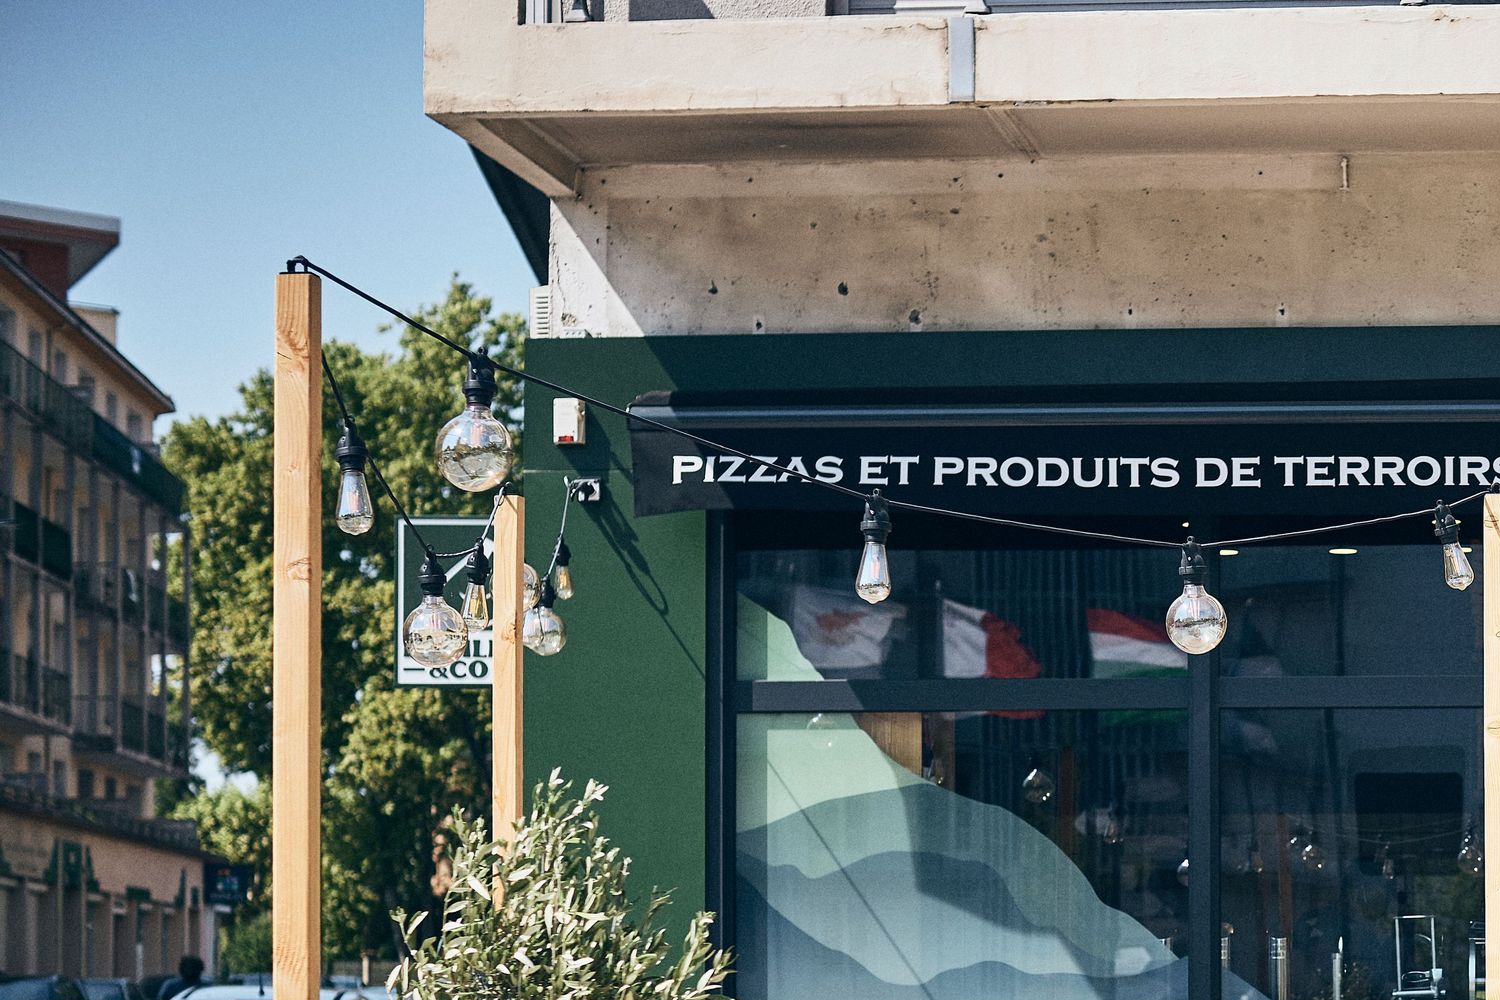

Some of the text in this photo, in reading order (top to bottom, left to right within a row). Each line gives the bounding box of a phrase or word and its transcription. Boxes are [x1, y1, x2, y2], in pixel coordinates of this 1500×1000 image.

[672, 455, 844, 485] PIZZAS
[859, 455, 920, 486] ET
[933, 456, 1180, 488] PRODUITS
[1195, 456, 1262, 488] DE
